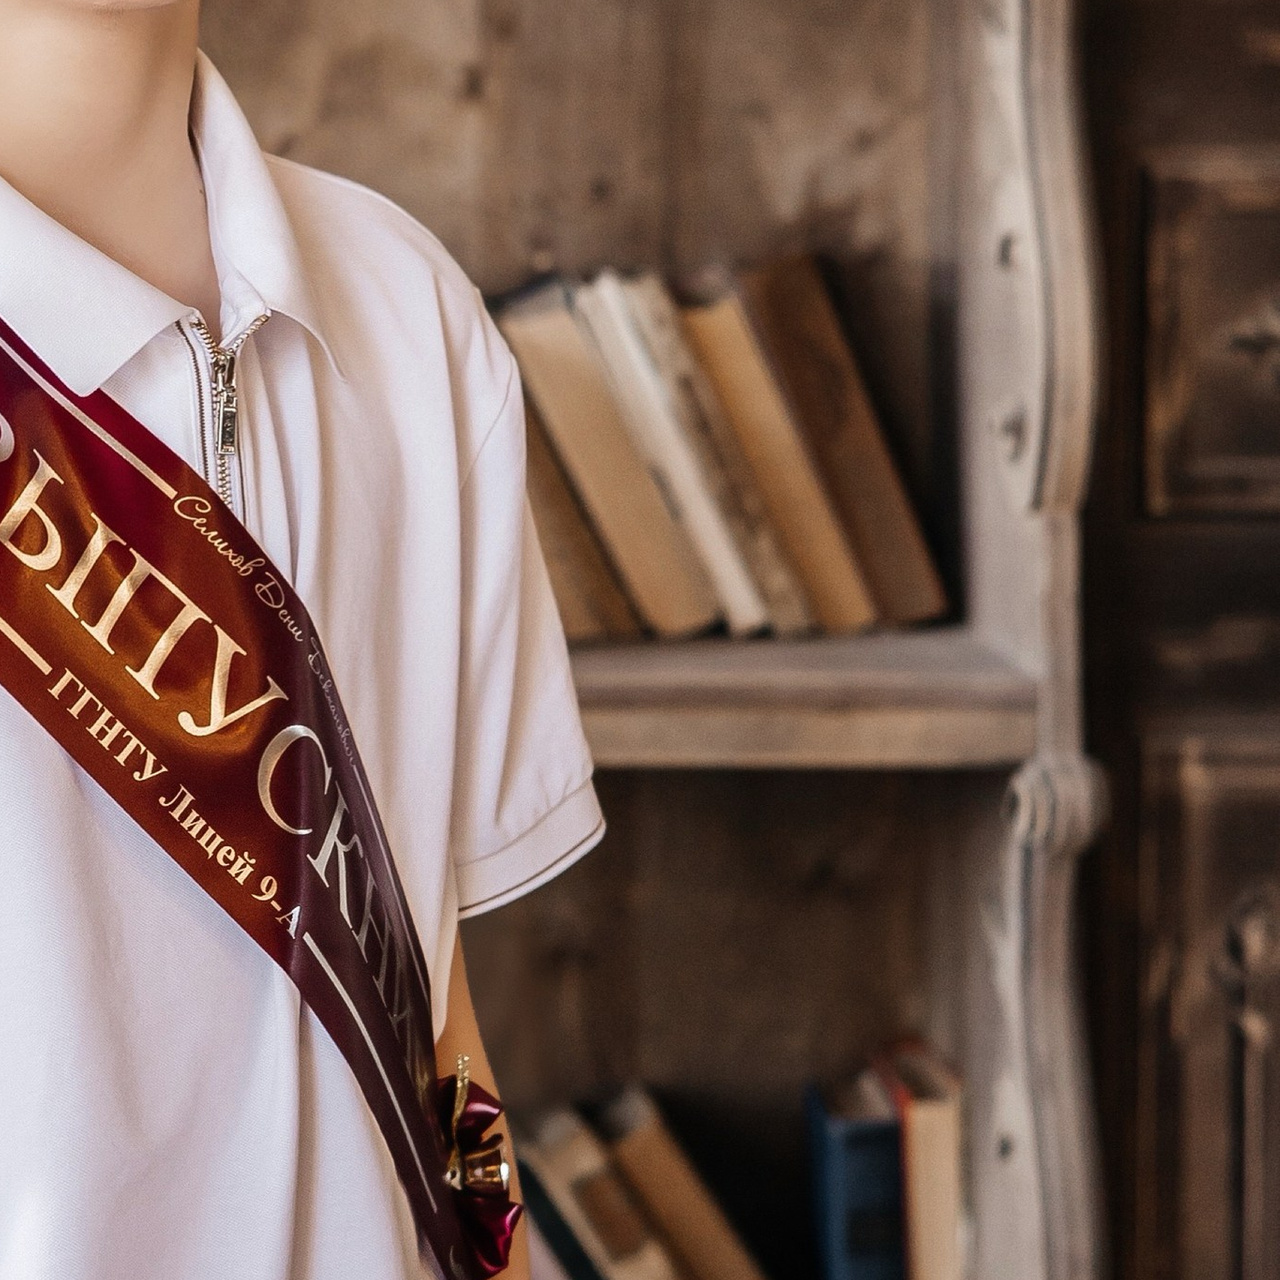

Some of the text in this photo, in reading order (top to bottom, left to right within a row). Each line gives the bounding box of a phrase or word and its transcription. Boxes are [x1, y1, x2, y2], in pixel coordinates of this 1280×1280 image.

[174, 495, 265, 577] Селихов
[254, 571, 304, 642] Дени
[47, 667, 302, 940] ГГНТУ Лицей 9-А
